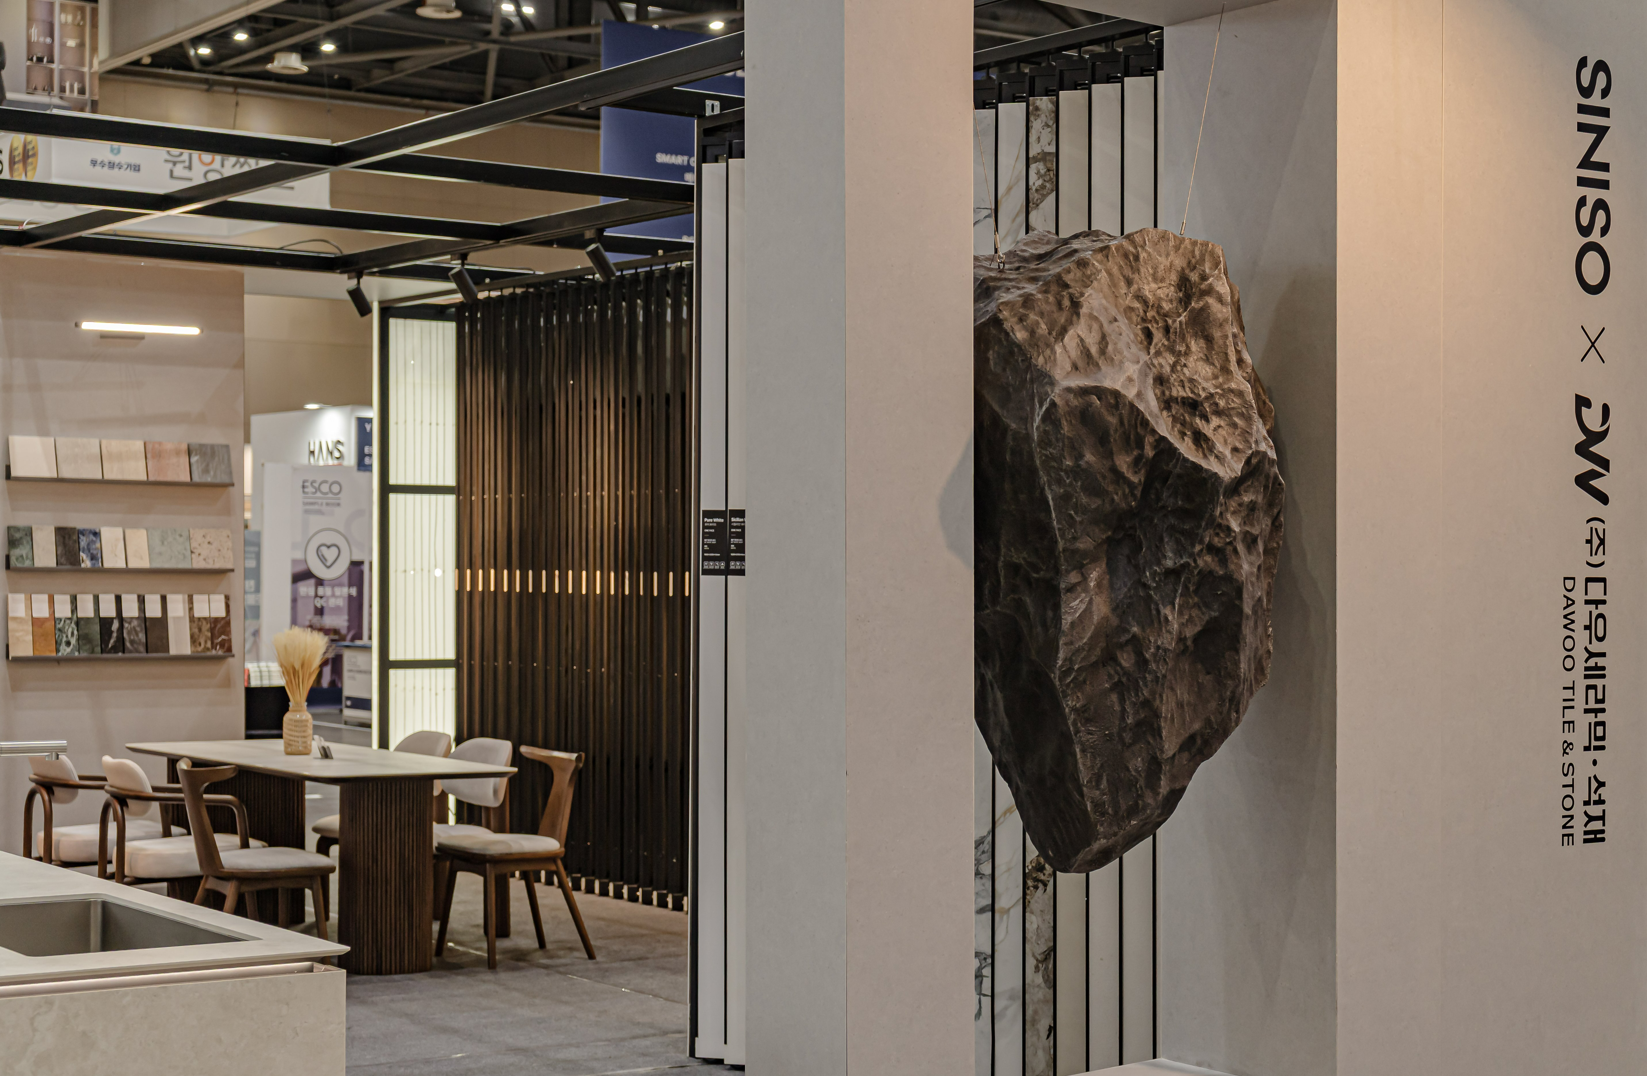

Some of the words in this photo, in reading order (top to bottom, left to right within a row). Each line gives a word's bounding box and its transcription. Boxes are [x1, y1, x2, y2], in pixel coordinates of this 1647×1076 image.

[655, 152, 689, 166] SMART
[1574, 55, 1612, 296] SINISO
[308, 439, 344, 464] HANS
[301, 479, 342, 496] ESCO
[1562, 576, 1576, 672] DAWOO
[1561, 679, 1576, 734] TILE
[1561, 739, 1575, 758] &
[1561, 762, 1575, 847] STONE
